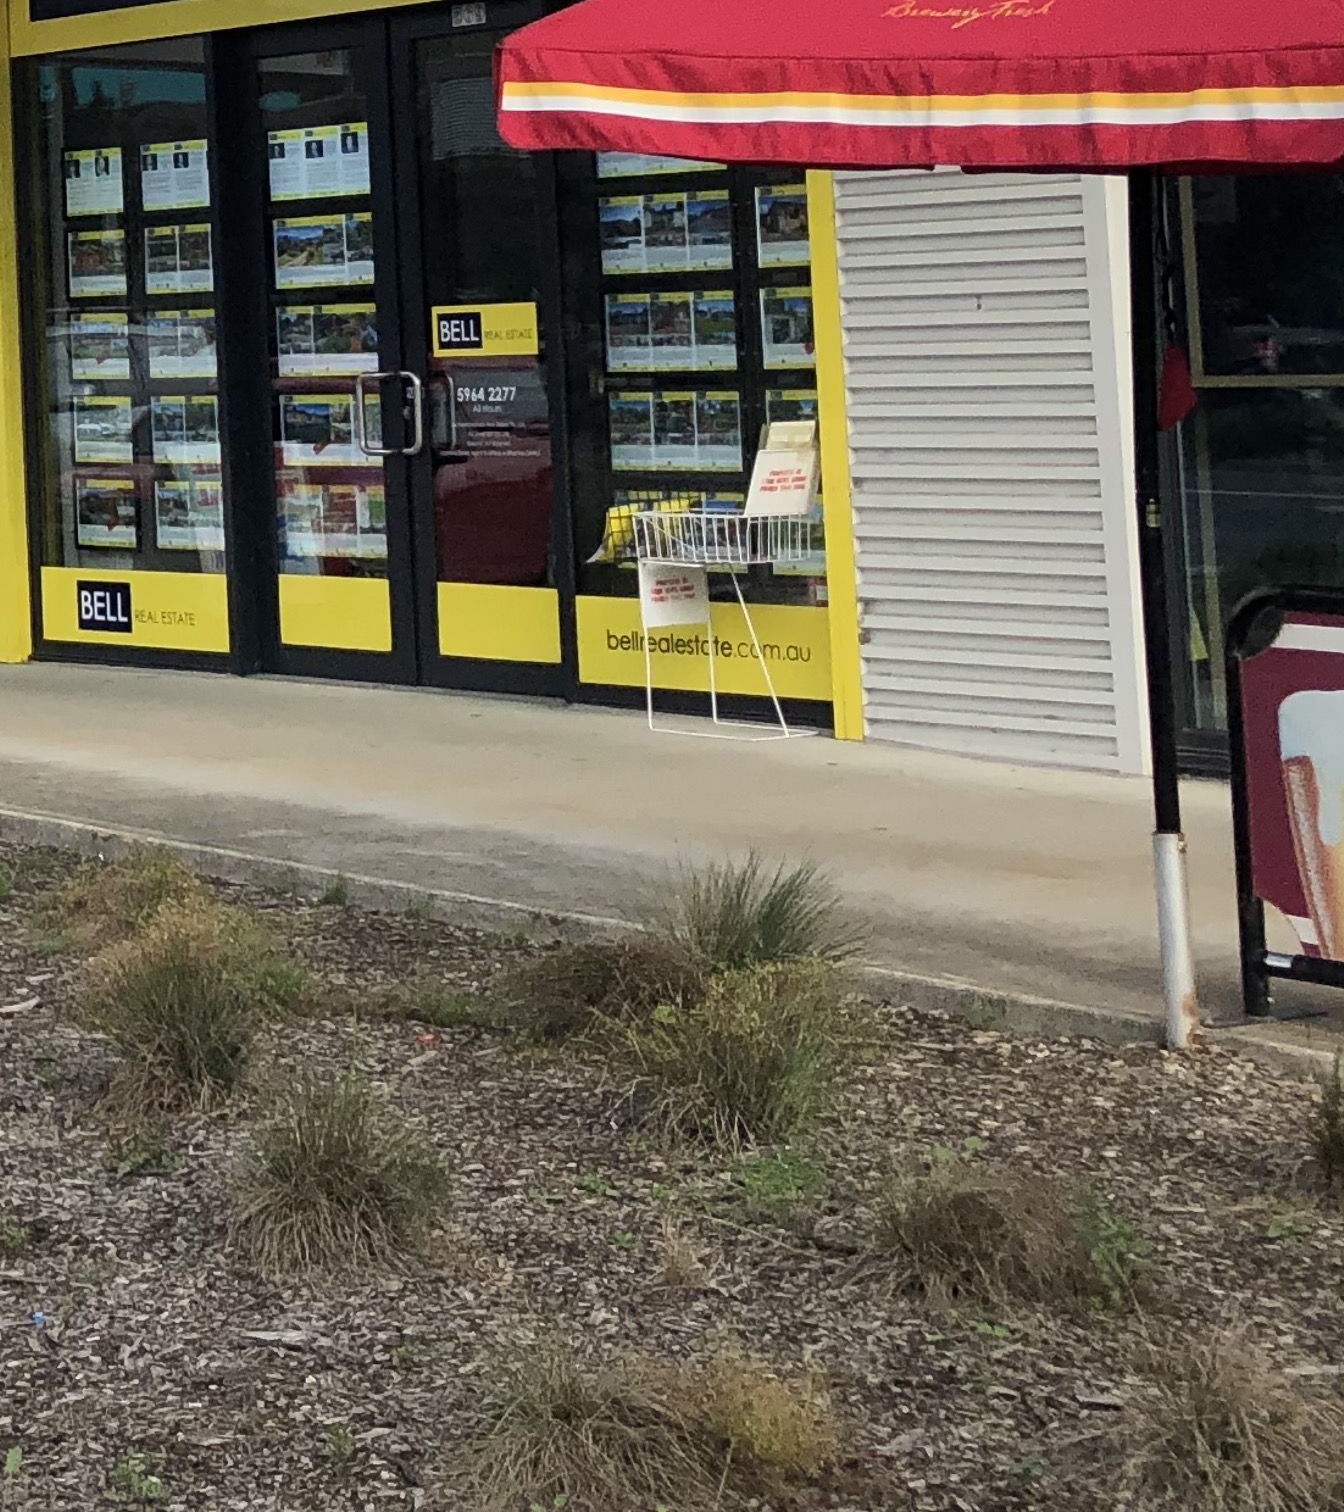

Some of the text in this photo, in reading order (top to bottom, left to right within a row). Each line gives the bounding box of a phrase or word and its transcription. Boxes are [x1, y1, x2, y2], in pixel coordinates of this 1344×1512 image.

[440, 320, 479, 342] BELL
[457, 386, 517, 402] 5964 2277
[81, 590, 128, 623] BELL
[135, 609, 196, 627] REAL ESTATE
[607, 629, 811, 663] bellrealestate.com.au
